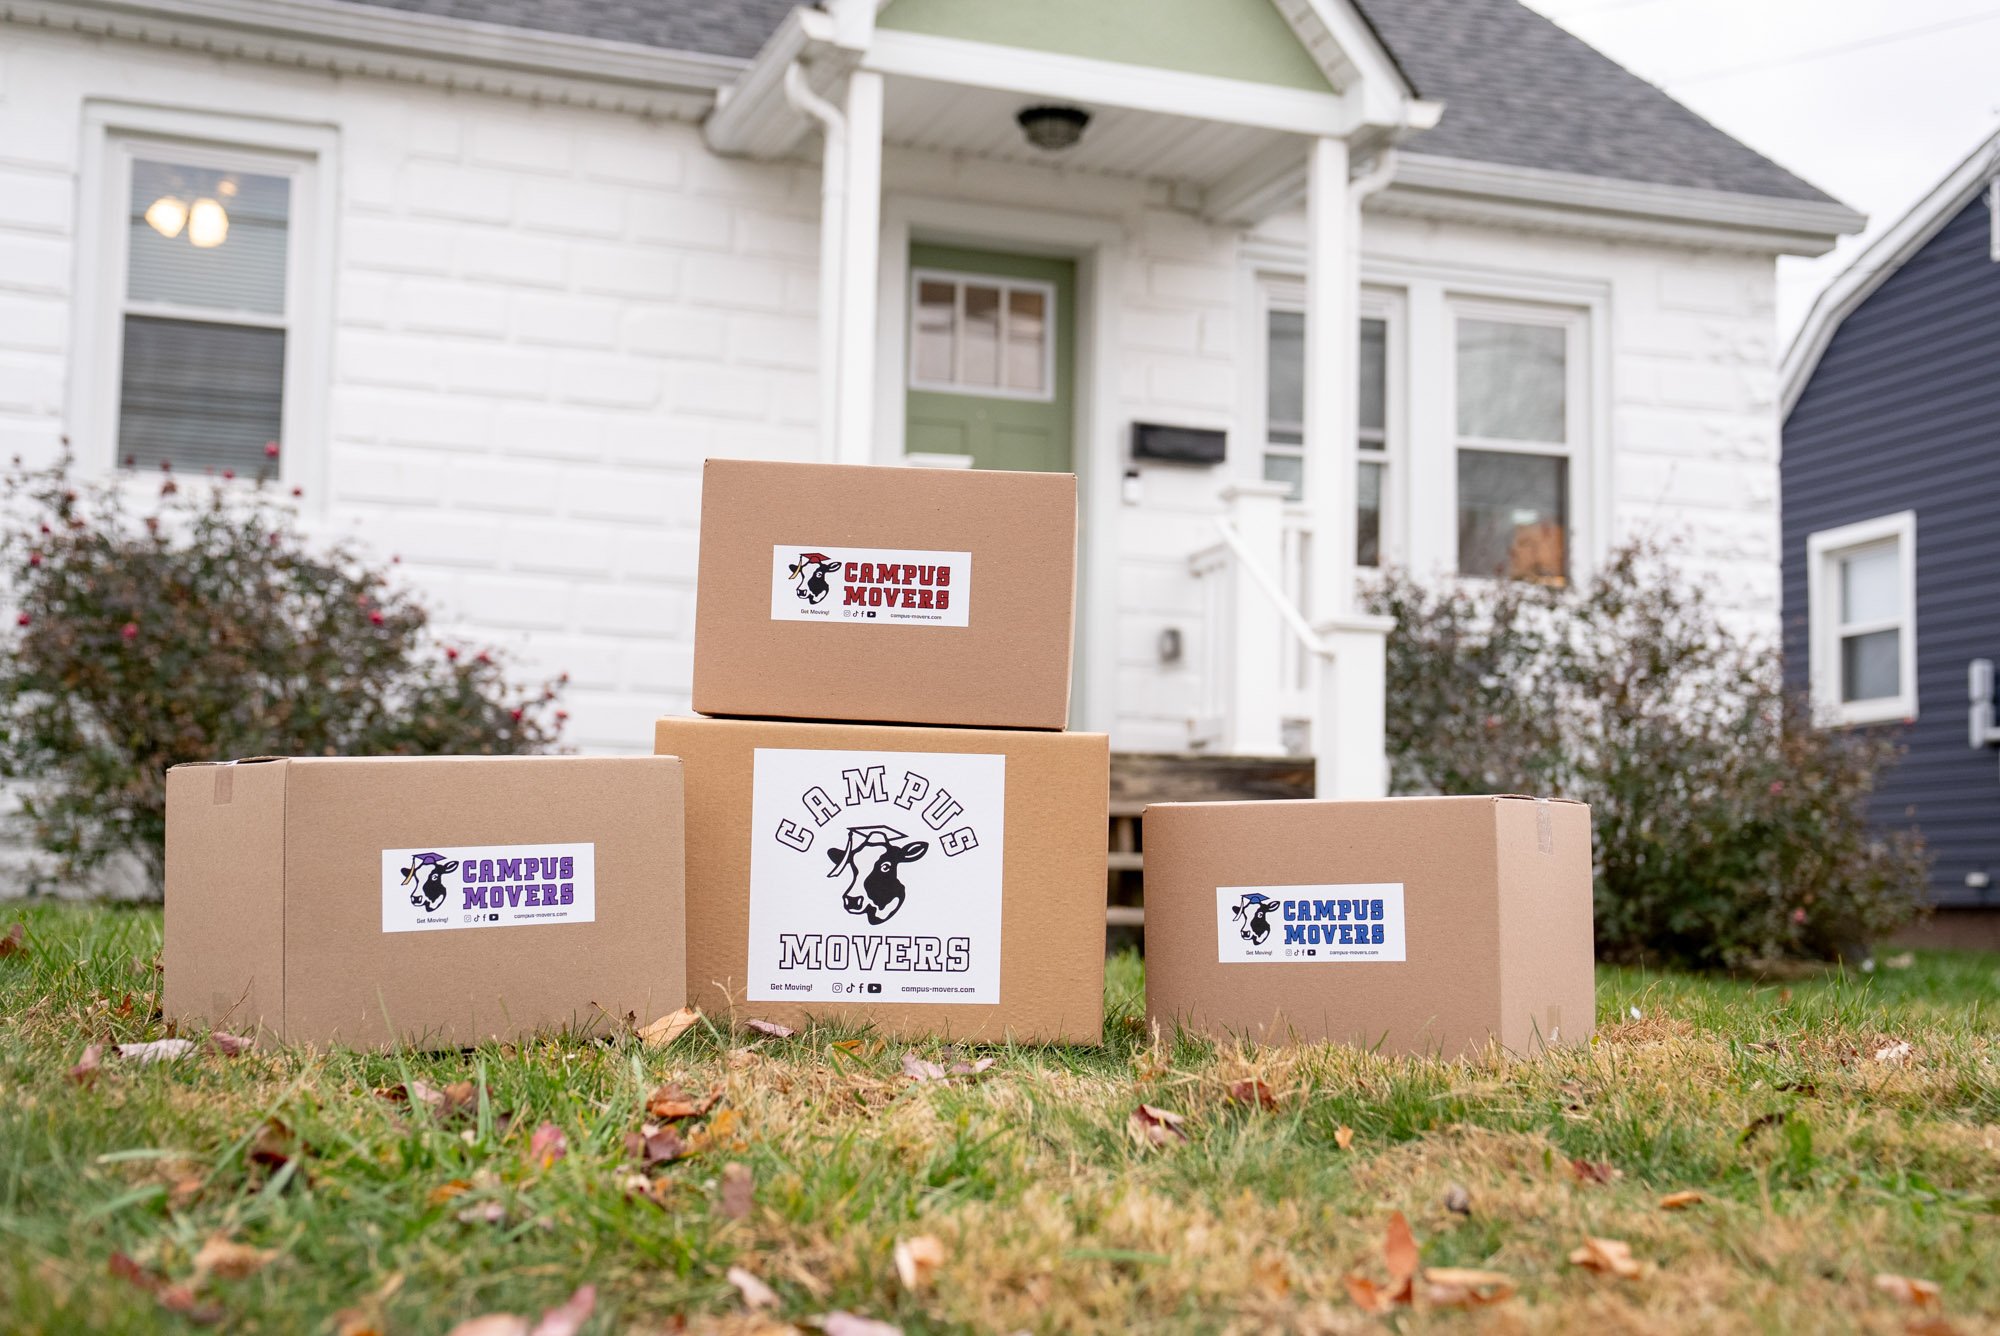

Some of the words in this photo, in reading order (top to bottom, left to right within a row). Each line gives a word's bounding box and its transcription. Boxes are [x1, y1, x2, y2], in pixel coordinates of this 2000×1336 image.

[844, 562, 951, 587] CAMPUS
[843, 585, 950, 610] MOVERS
[775, 765, 979, 857] CAMPUS
[462, 856, 574, 883] CAMPUS
[462, 882, 574, 910] MOVERS
[514, 911, 568, 919] campus-movers.com
[1283, 899, 1384, 922] CAMPUS
[1284, 923, 1385, 945] MOVERS
[779, 933, 970, 973] MOVERS
[770, 983, 783, 991] Get
[784, 983, 813, 992] Moving!
[901, 985, 975, 993] campus-movers.com
